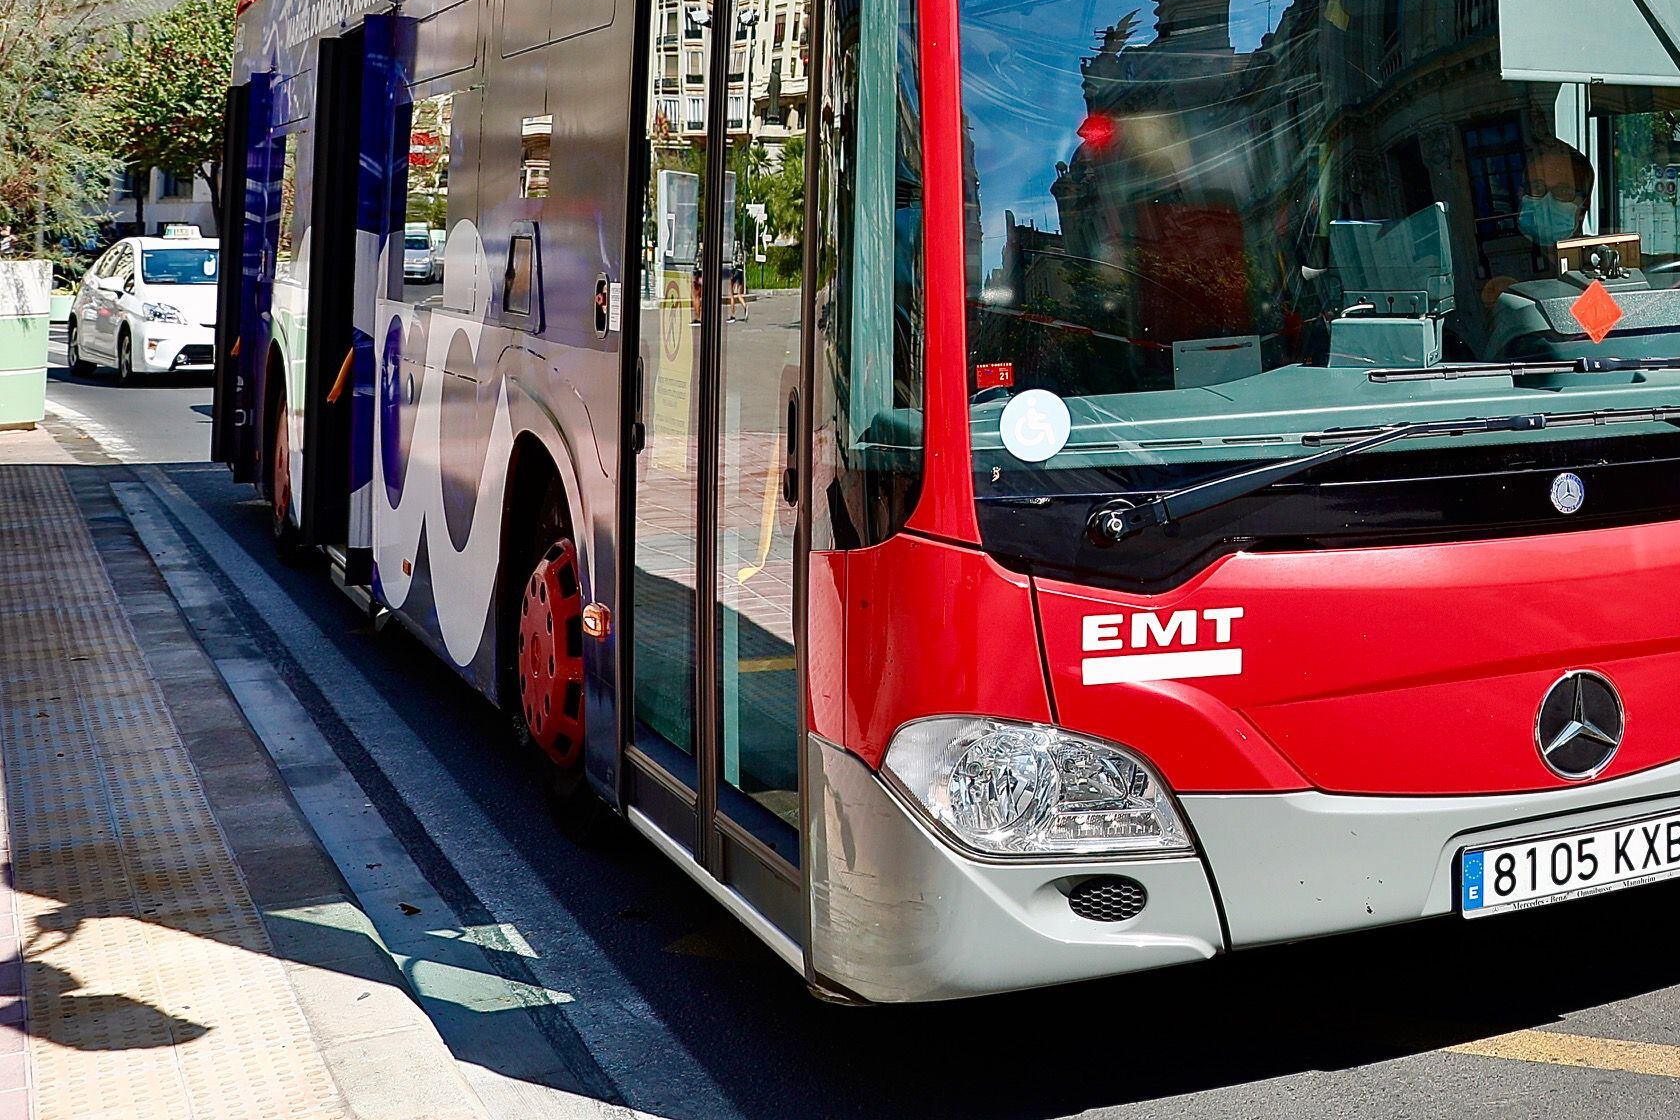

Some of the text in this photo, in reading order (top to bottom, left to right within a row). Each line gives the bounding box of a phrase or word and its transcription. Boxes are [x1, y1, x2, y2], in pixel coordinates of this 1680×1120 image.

[999, 371, 1009, 381] 21
[1081, 607, 1244, 651] EMT
[1494, 836, 1600, 897] 8105
[1622, 875, 1656, 888] Mannheim
[1468, 886, 1479, 899] E
